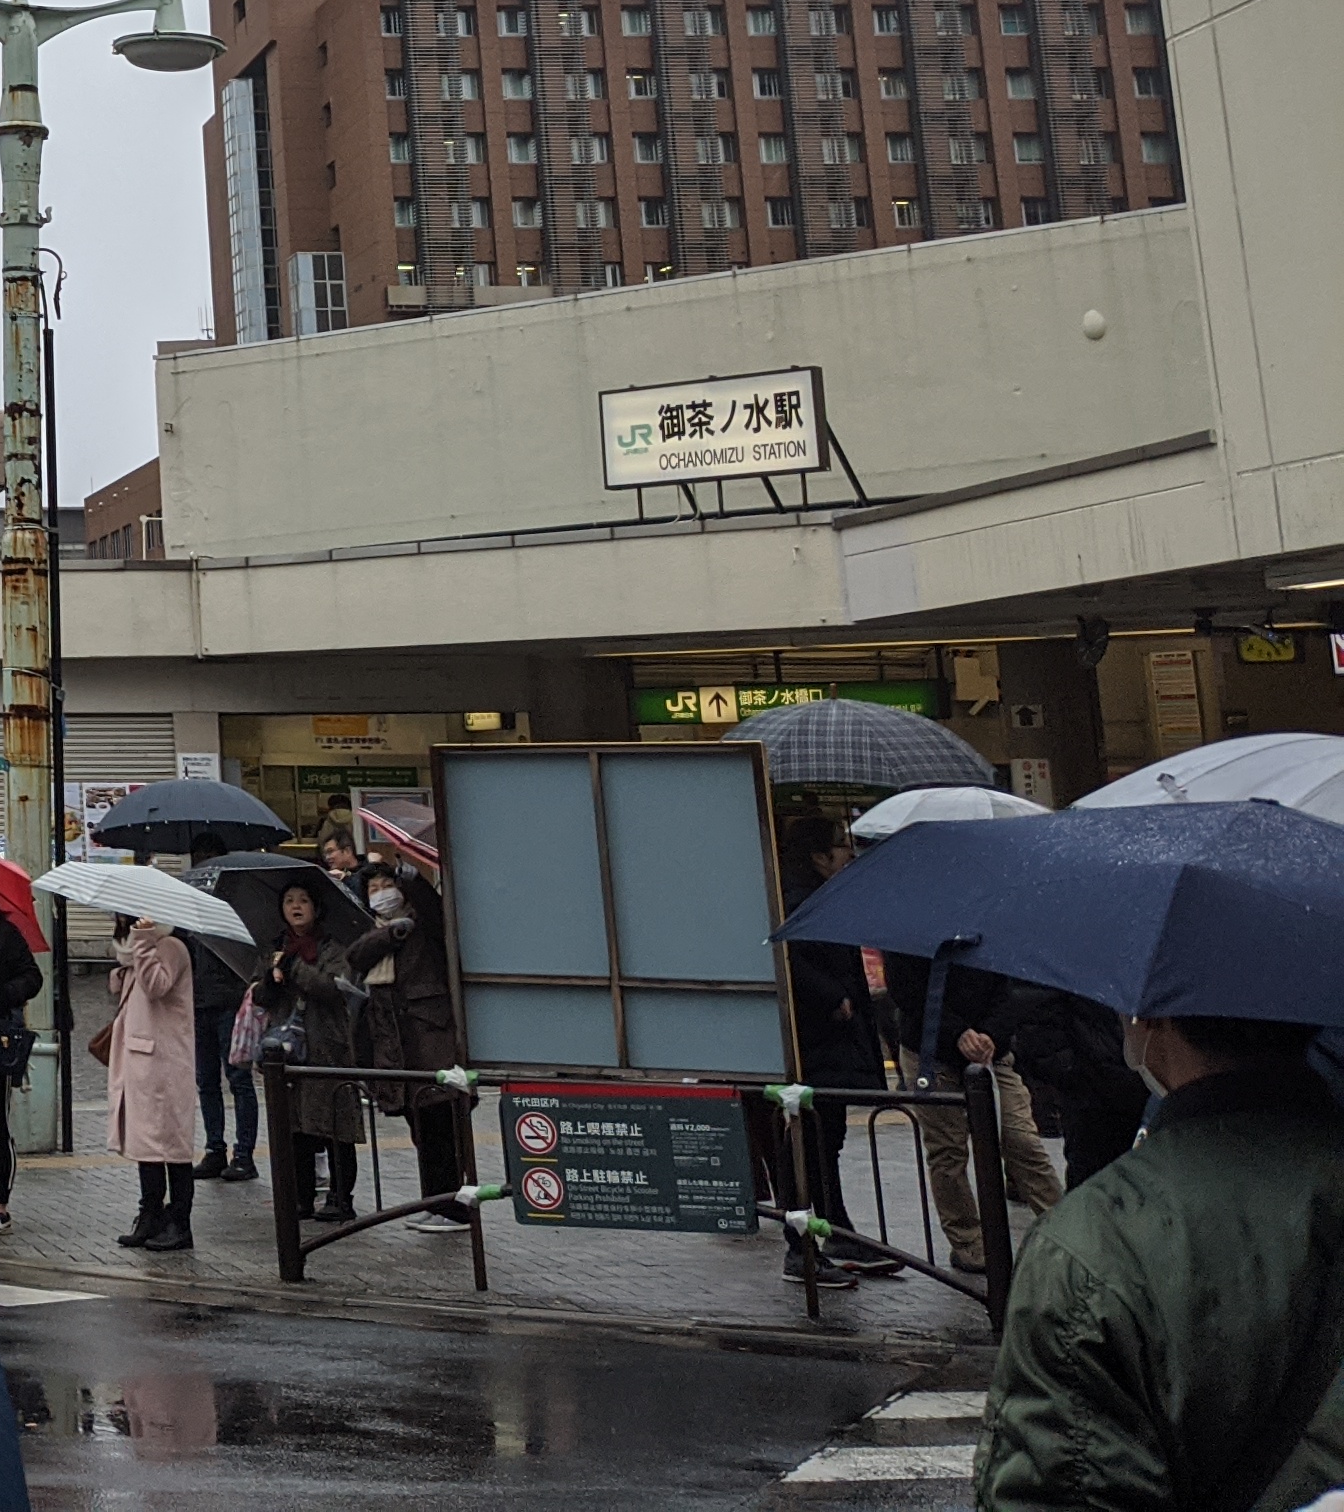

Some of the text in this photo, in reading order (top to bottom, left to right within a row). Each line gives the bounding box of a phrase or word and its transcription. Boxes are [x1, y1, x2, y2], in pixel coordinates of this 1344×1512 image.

[617, 390, 804, 449] JR 御茶ノ水駅
[659, 439, 807, 471] OCHANOMIZU STATION
[666, 688, 823, 712] JR 御茶ノ水橋口
[512, 1097, 560, 1108] 千代田区内
[560, 1121, 643, 1138] 路上喫煙禁止
[564, 1168, 649, 1185] 路上駐輪禁止
